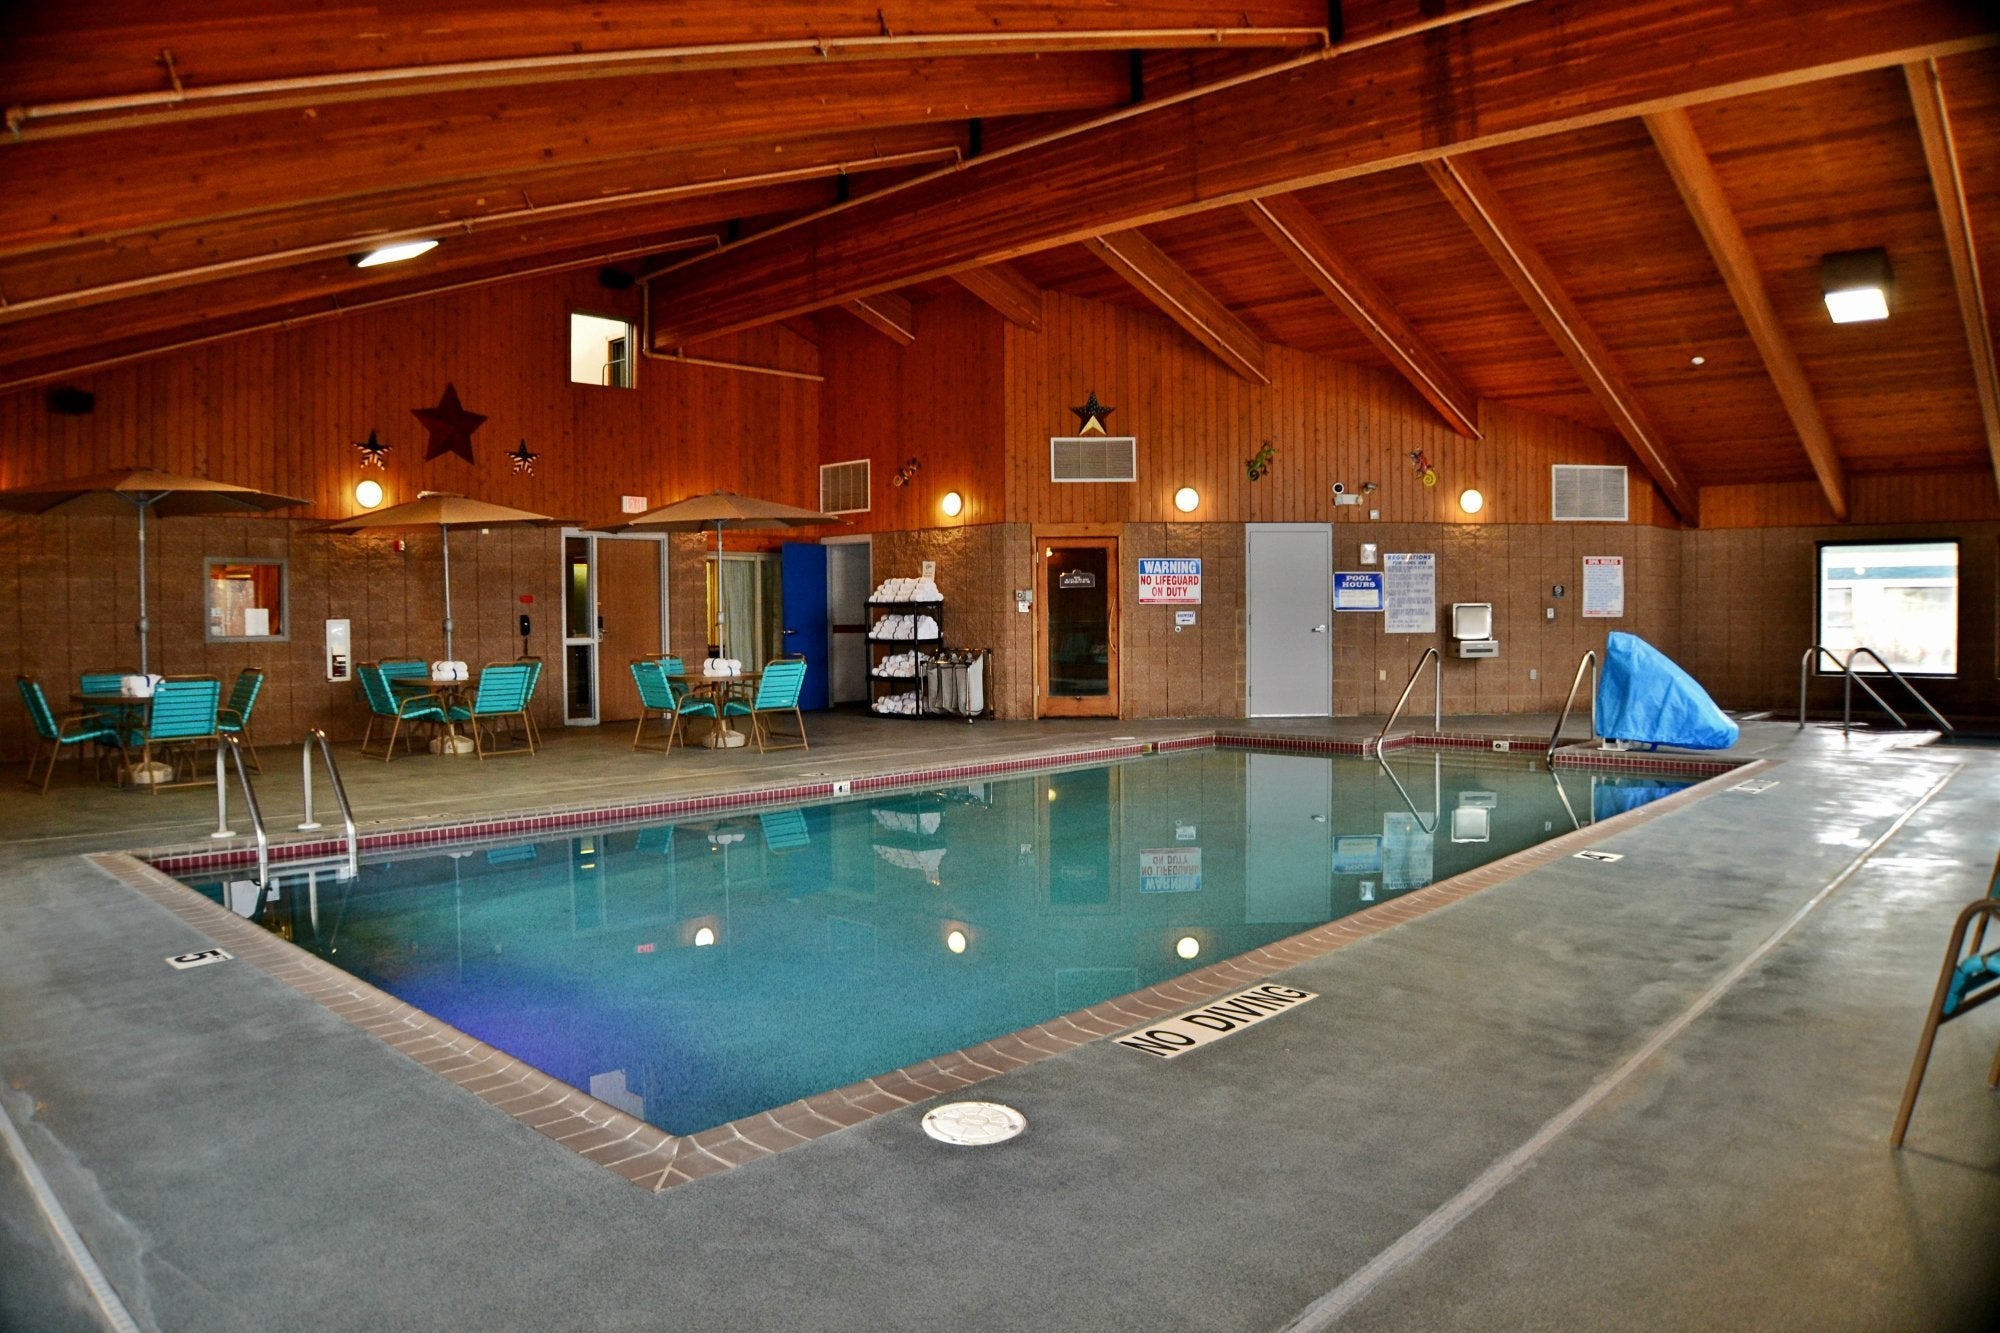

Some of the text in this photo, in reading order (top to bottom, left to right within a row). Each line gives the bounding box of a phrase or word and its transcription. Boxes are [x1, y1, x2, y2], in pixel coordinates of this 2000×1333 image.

[1144, 560, 1197, 574] WARNING
[1140, 576, 1199, 586] NO LIFEGUARD
[1152, 587, 1188, 597] ON DUTY
[174, 949, 221, 963] 5
[1119, 985, 1312, 1057] NO DIVING
